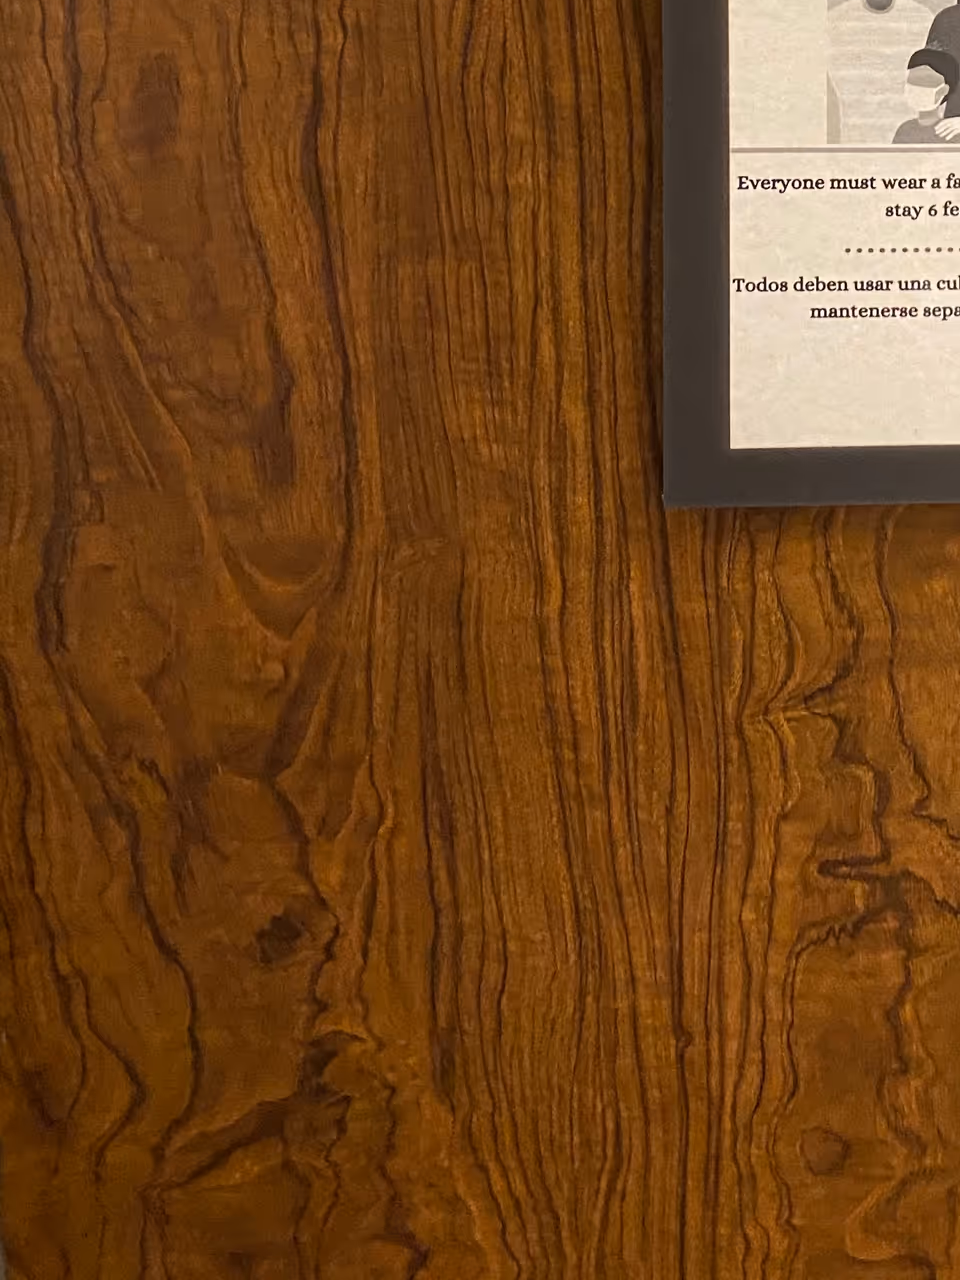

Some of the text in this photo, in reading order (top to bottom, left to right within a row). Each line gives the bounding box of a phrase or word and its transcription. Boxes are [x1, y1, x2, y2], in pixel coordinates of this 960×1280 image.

[736, 175, 825, 194] Everyone
[829, 176, 877, 190] must
[881, 178, 928, 190] wear
[930, 177, 942, 190] a
[885, 203, 924, 221] stay
[927, 204, 938, 217] 6
[732, 276, 789, 293] Todos
[793, 275, 849, 292] deben
[853, 279, 894, 292] usar
[897, 279, 932, 291] una
[810, 305, 919, 319] mantenerse
